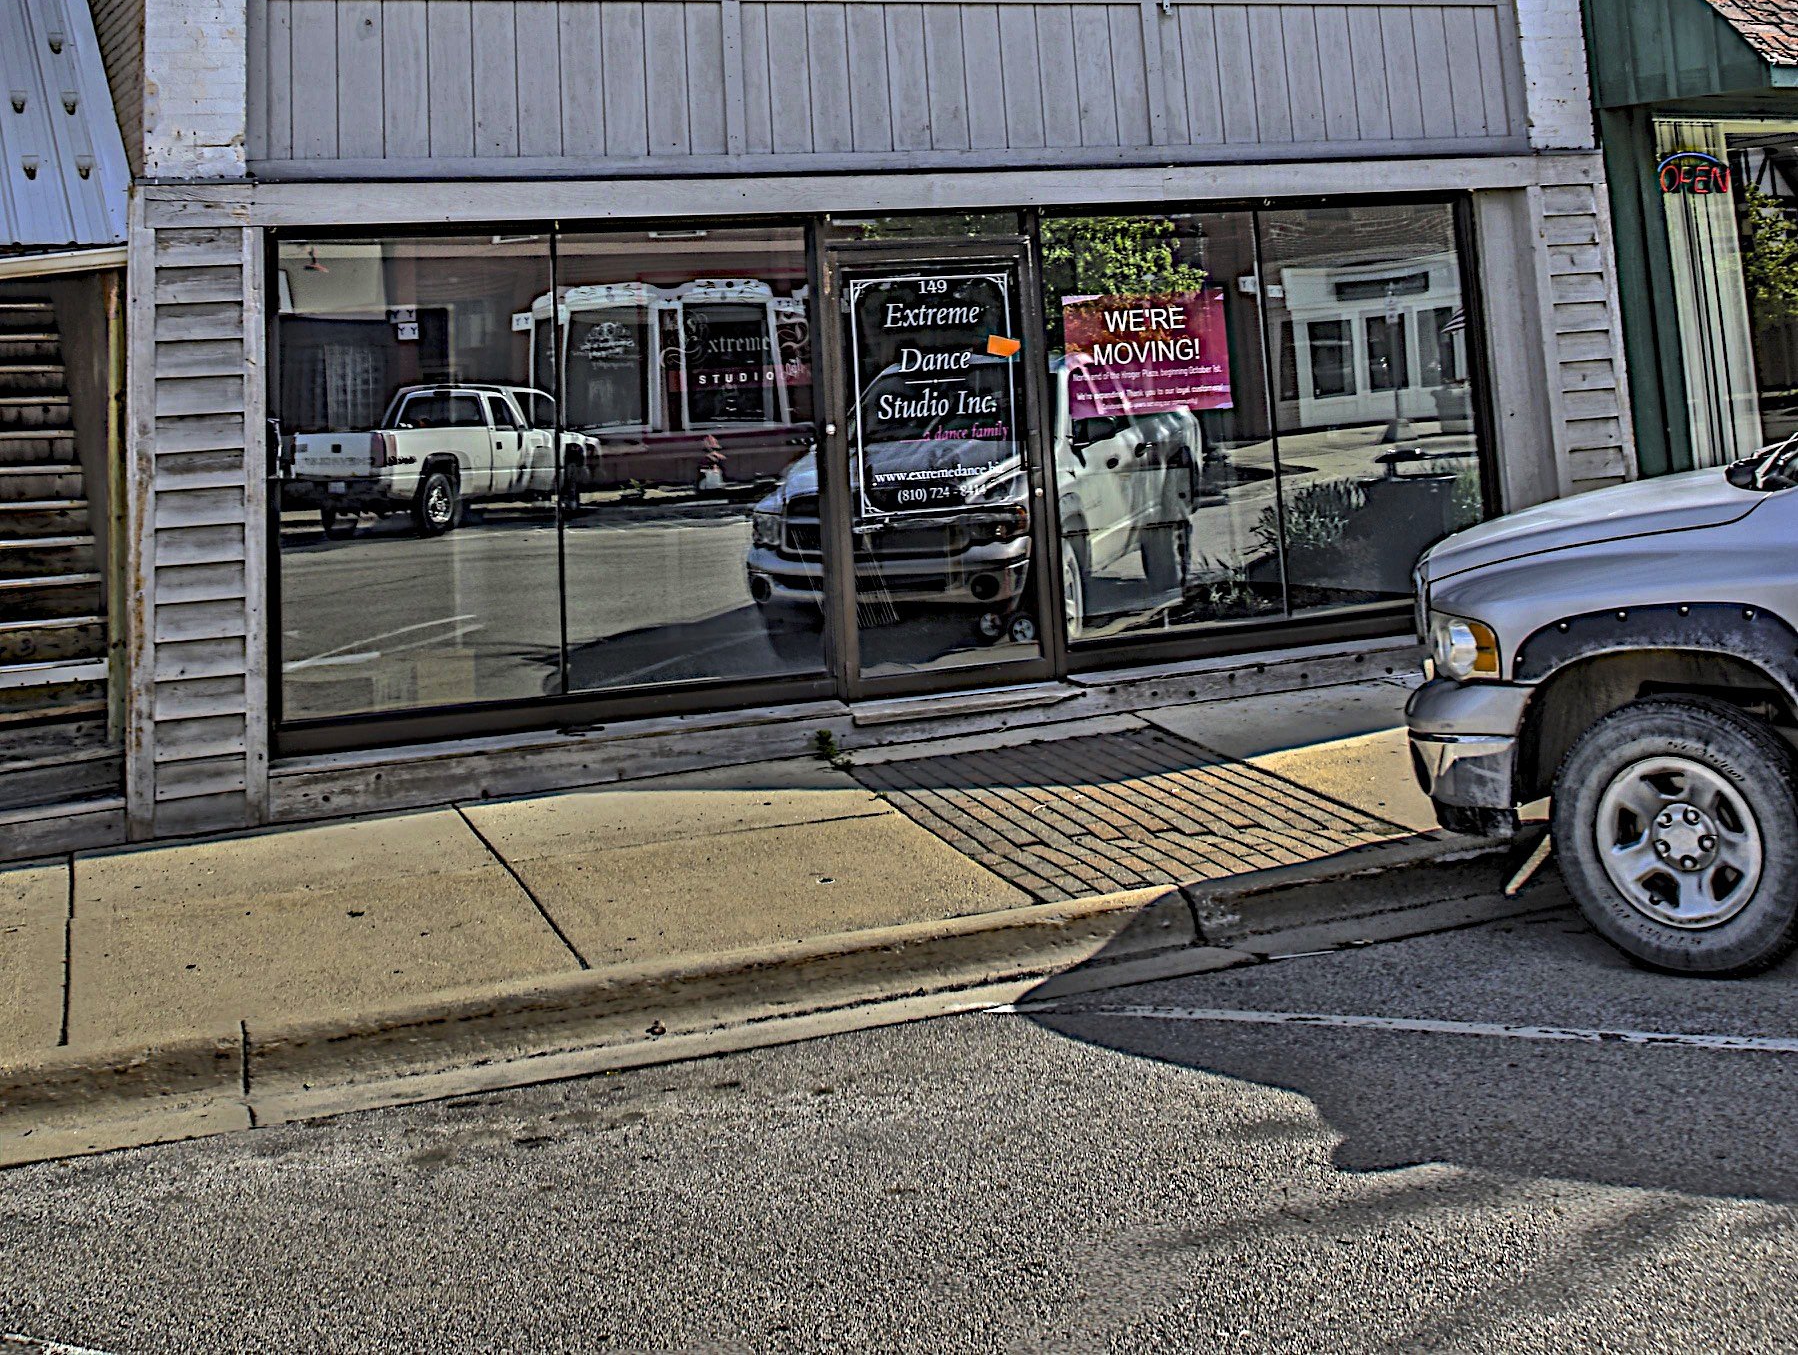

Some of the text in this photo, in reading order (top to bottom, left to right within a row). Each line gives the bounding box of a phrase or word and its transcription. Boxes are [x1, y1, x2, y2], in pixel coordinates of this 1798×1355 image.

[1659, 165, 1731, 193] OPEN
[918, 279, 947, 294] 149
[883, 303, 980, 328] Extreme
[1104, 307, 1186, 333] WE'RE
[898, 348, 972, 373] Dance
[1093, 338, 1201, 366] MOVING!
[698, 371, 775, 385] STUDIO
[1159, 367, 1188, 378] beginning
[1188, 365, 1212, 375] October
[877, 387, 997, 420] Studio Inc.
[934, 425, 968, 440] dance
[971, 420, 1009, 441] family
[874, 461, 1003, 483] www.extremedance.bi
[897, 488, 928, 504] (810)
[929, 486, 950, 499] 724
